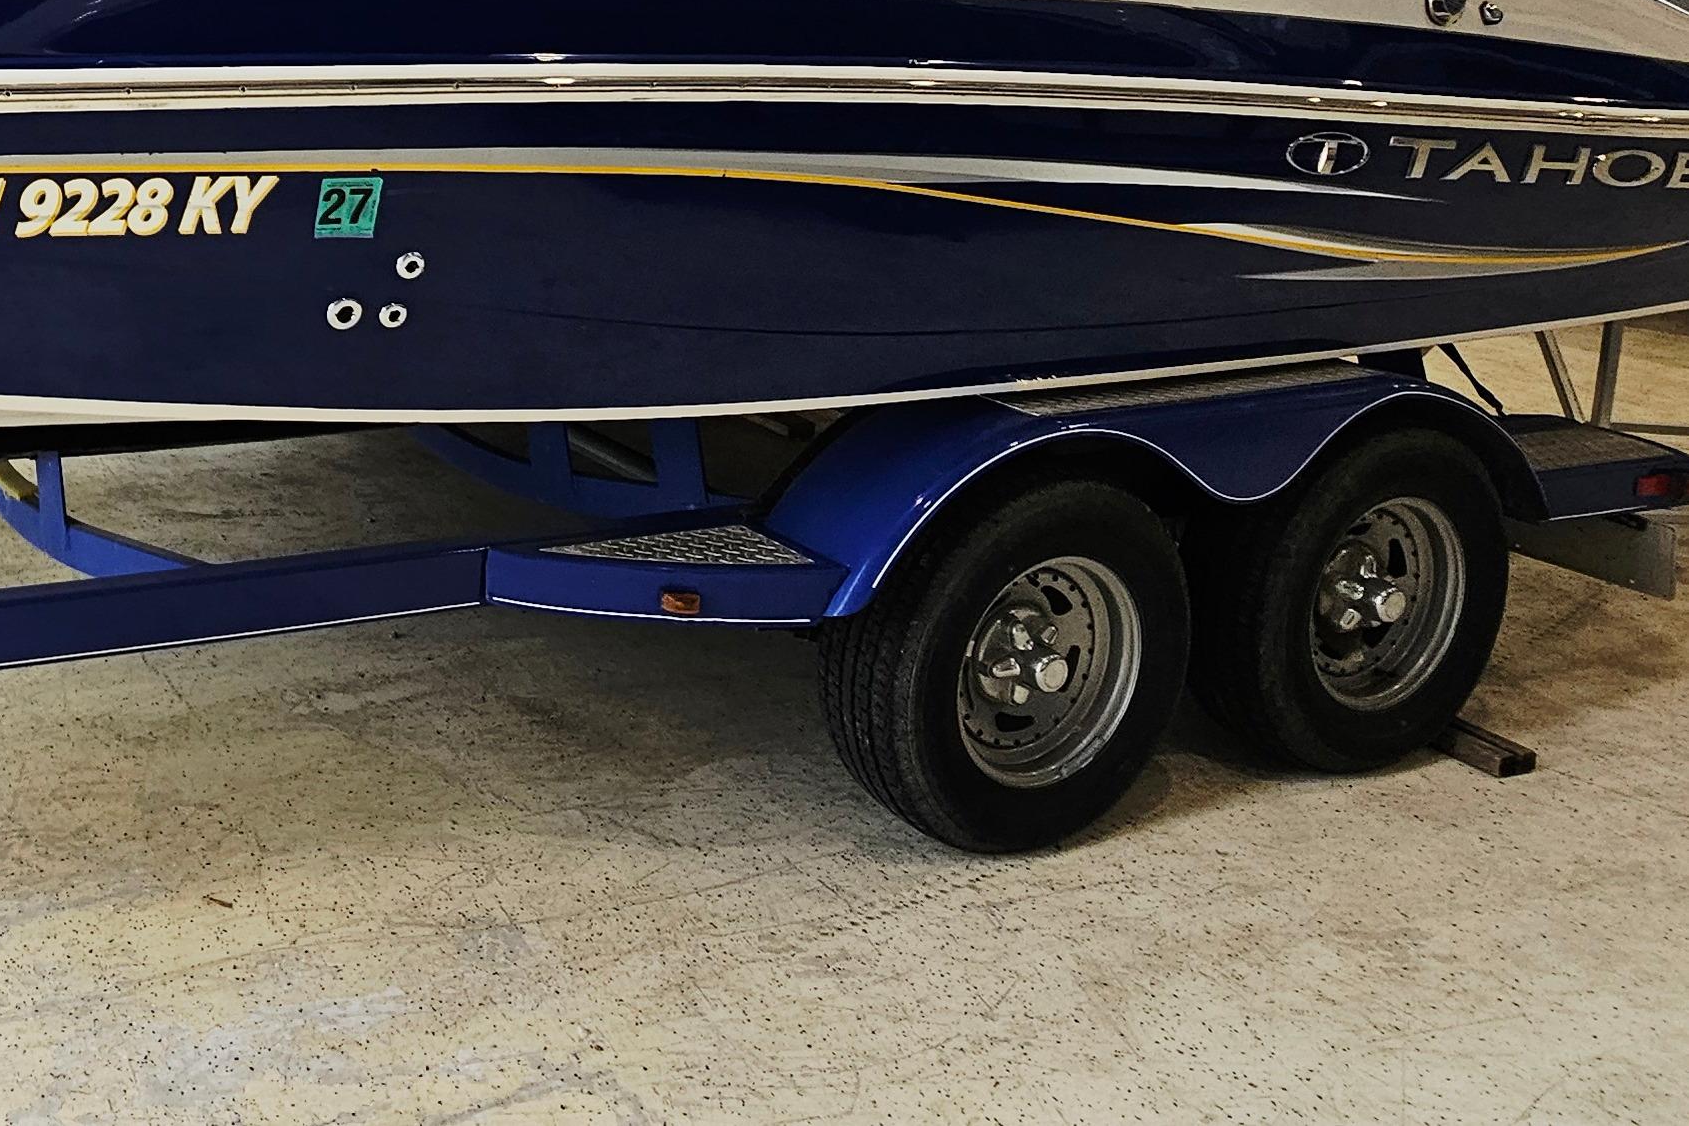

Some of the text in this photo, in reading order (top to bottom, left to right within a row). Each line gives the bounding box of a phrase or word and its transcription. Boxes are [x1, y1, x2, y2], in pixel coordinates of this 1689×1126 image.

[15, 177, 173, 238] 9228
[179, 175, 279, 236] KY
[318, 188, 374, 225] 27
